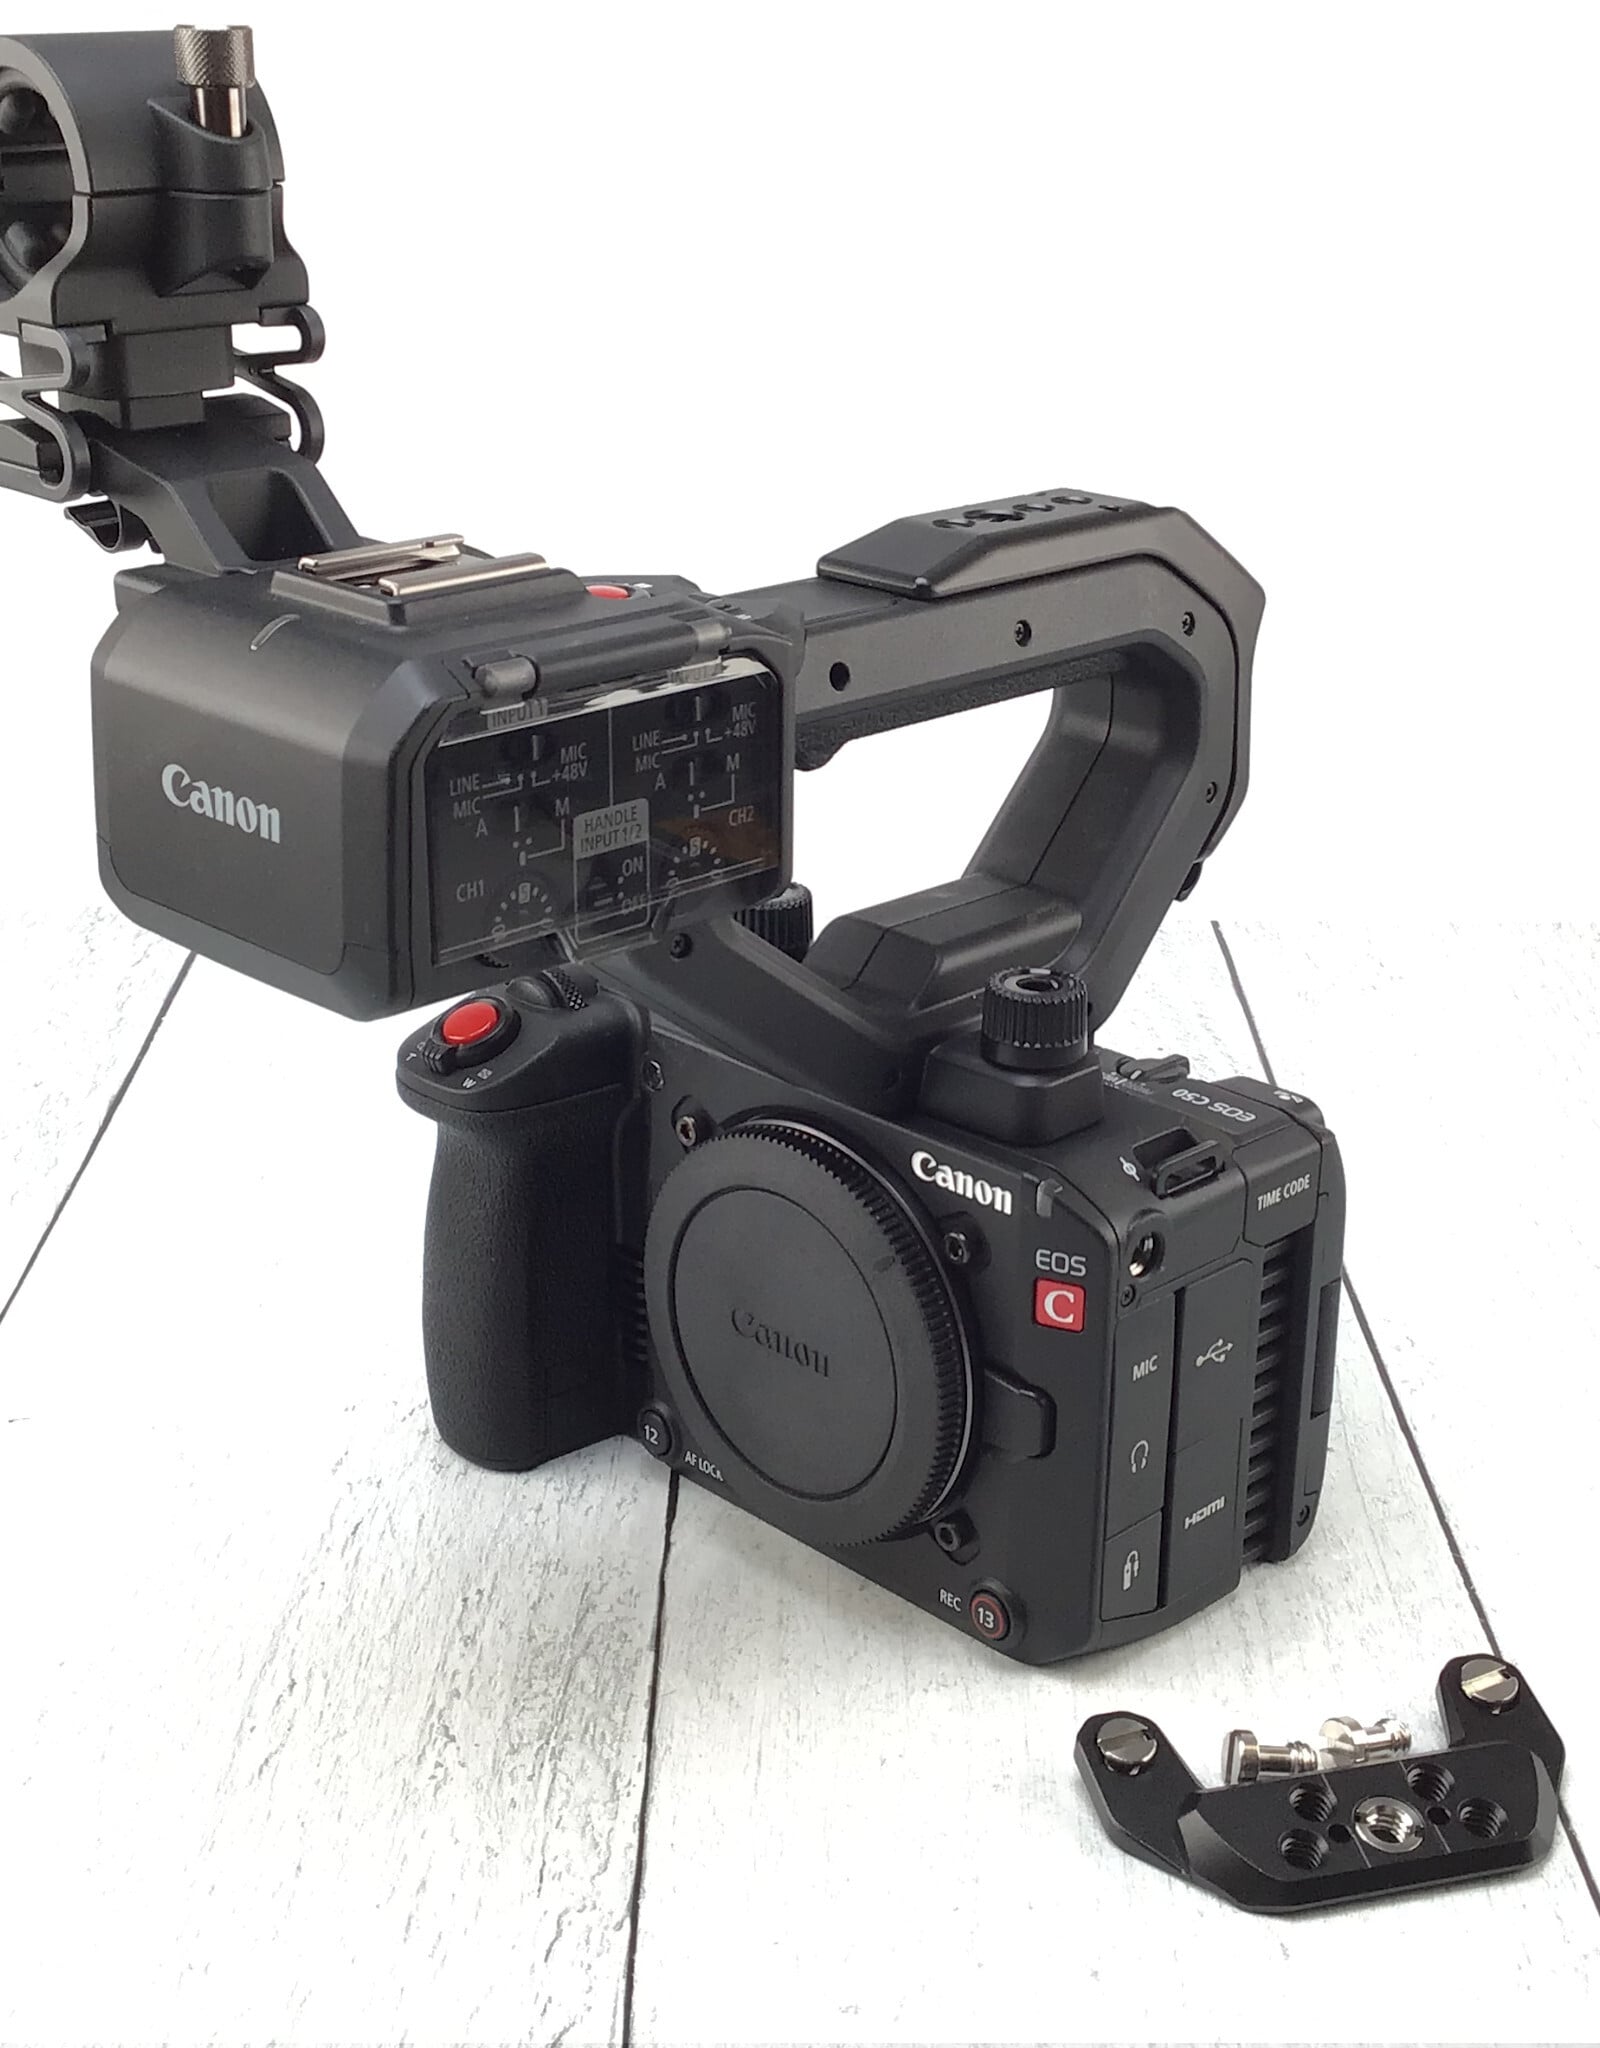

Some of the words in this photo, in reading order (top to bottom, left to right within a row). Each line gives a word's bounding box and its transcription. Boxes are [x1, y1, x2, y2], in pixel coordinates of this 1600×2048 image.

[732, 702, 756, 722] MIC
[725, 719, 757, 738] +48V
[632, 730, 660, 751] LINE
[560, 742, 587, 764] MIC
[635, 752, 661, 773] MIC
[726, 752, 740, 772] M
[552, 760, 588, 782] +48V
[654, 772, 667, 790] A
[450, 774, 480, 797] LINE
[162, 763, 280, 844] Canon
[453, 797, 481, 820] MIC
[555, 797, 570, 817] M
[584, 806, 638, 833] HANDLE
[728, 806, 755, 827] CH2
[476, 818, 488, 838] A
[622, 856, 644, 877] ON
[456, 879, 484, 902] CH1
[462, 1077, 477, 1089] W
[1172, 1088, 1210, 1106] C50
[1208, 1102, 1256, 1123] EOS
[911, 1151, 1013, 1216] Canon
[1257, 1187, 1282, 1211] TIME
[1283, 1174, 1310, 1199] CODE
[1035, 1249, 1087, 1277] EOS
[1045, 1290, 1075, 1324] C
[731, 1308, 830, 1378] Canon
[1132, 1355, 1158, 1381] MIC
[644, 1425, 659, 1445] 12
[685, 1451, 697, 1467] AF
[699, 1458, 724, 1482] LOCK
[1184, 1496, 1225, 1530] HDMI
[940, 1588, 962, 1612] REC
[978, 1607, 995, 1629] 13
